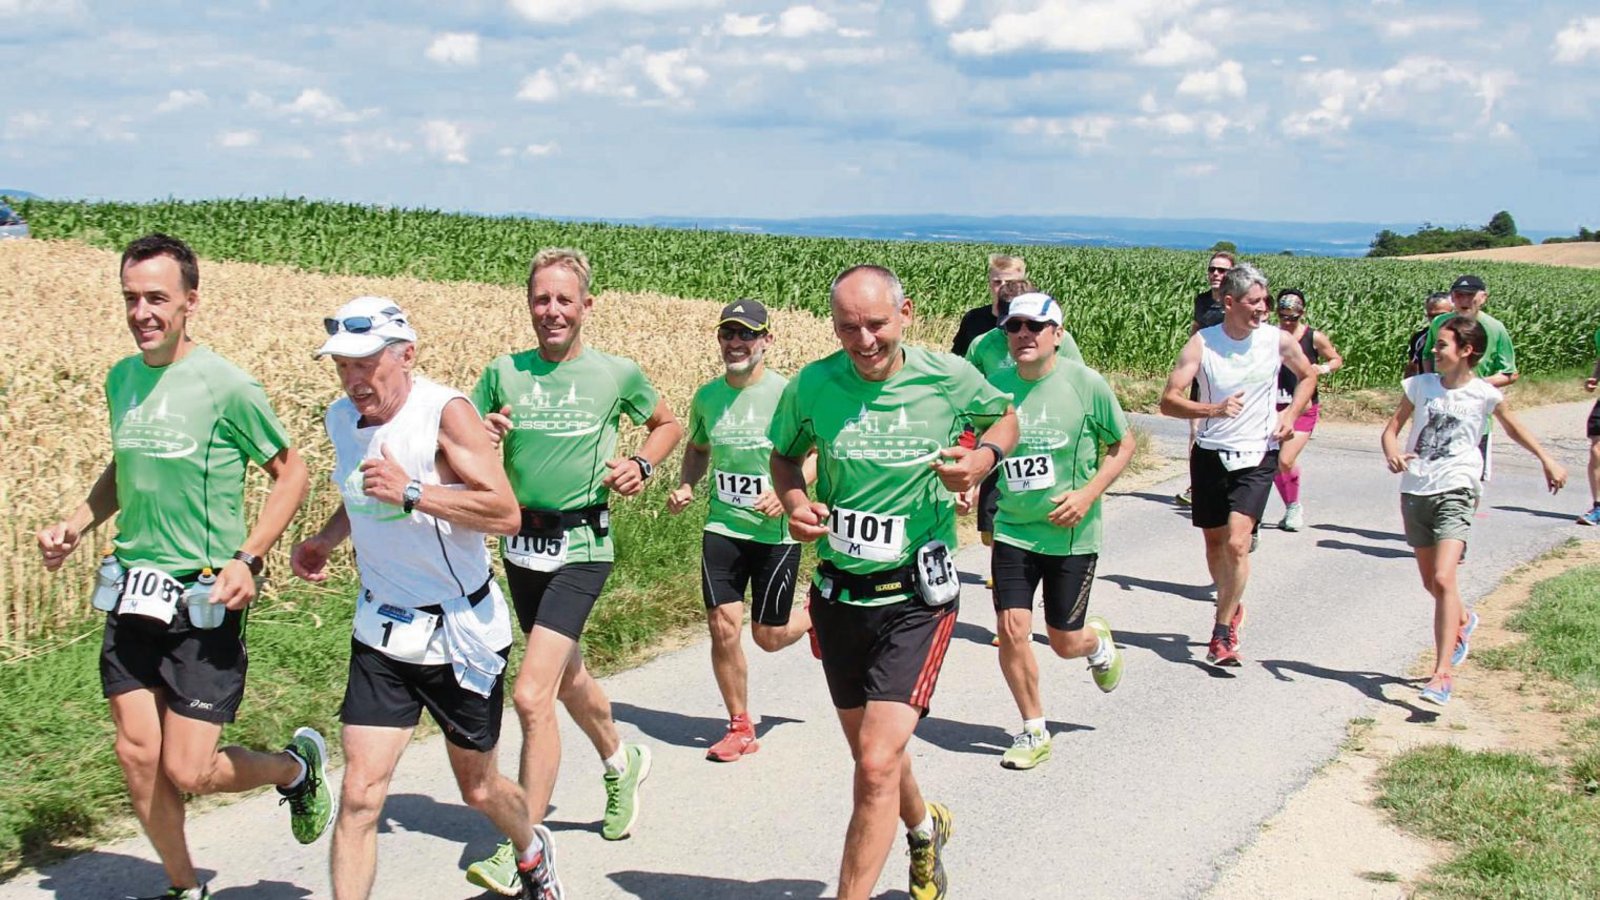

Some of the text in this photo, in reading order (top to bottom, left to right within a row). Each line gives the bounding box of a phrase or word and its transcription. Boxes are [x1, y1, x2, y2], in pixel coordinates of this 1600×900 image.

[1004, 456, 1049, 479] 1123
[717, 473, 763, 495] 1121
[1022, 480, 1031, 489] M
[731, 496, 742, 505] M
[829, 508, 895, 545] 1101
[847, 543, 862, 555] M
[381, 621, 394, 648] 1
